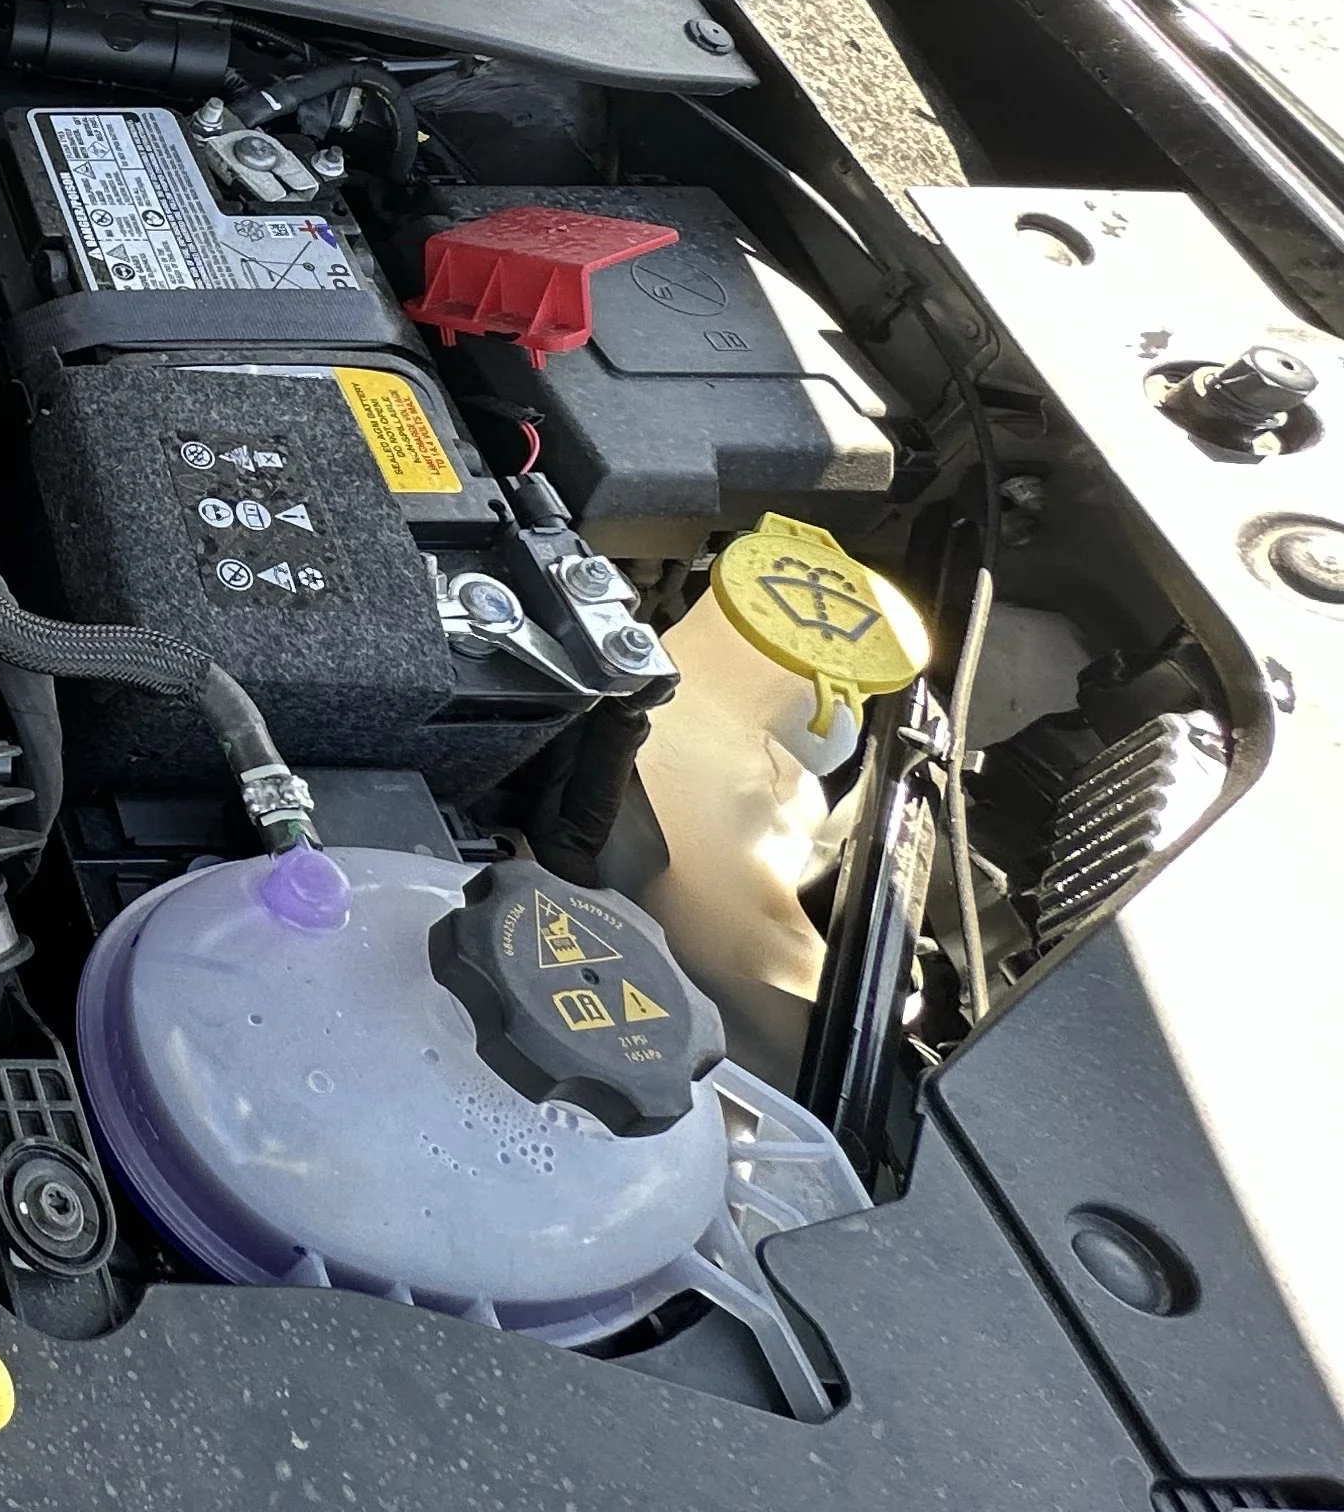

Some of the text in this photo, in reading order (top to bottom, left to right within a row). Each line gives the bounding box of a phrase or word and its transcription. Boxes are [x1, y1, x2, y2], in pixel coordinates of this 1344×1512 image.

[60, 173, 97, 247] DANGER/POISON
[351, 382, 375, 418] BATTERY
[370, 420, 385, 440] AGM
[384, 427, 398, 443] NOT
